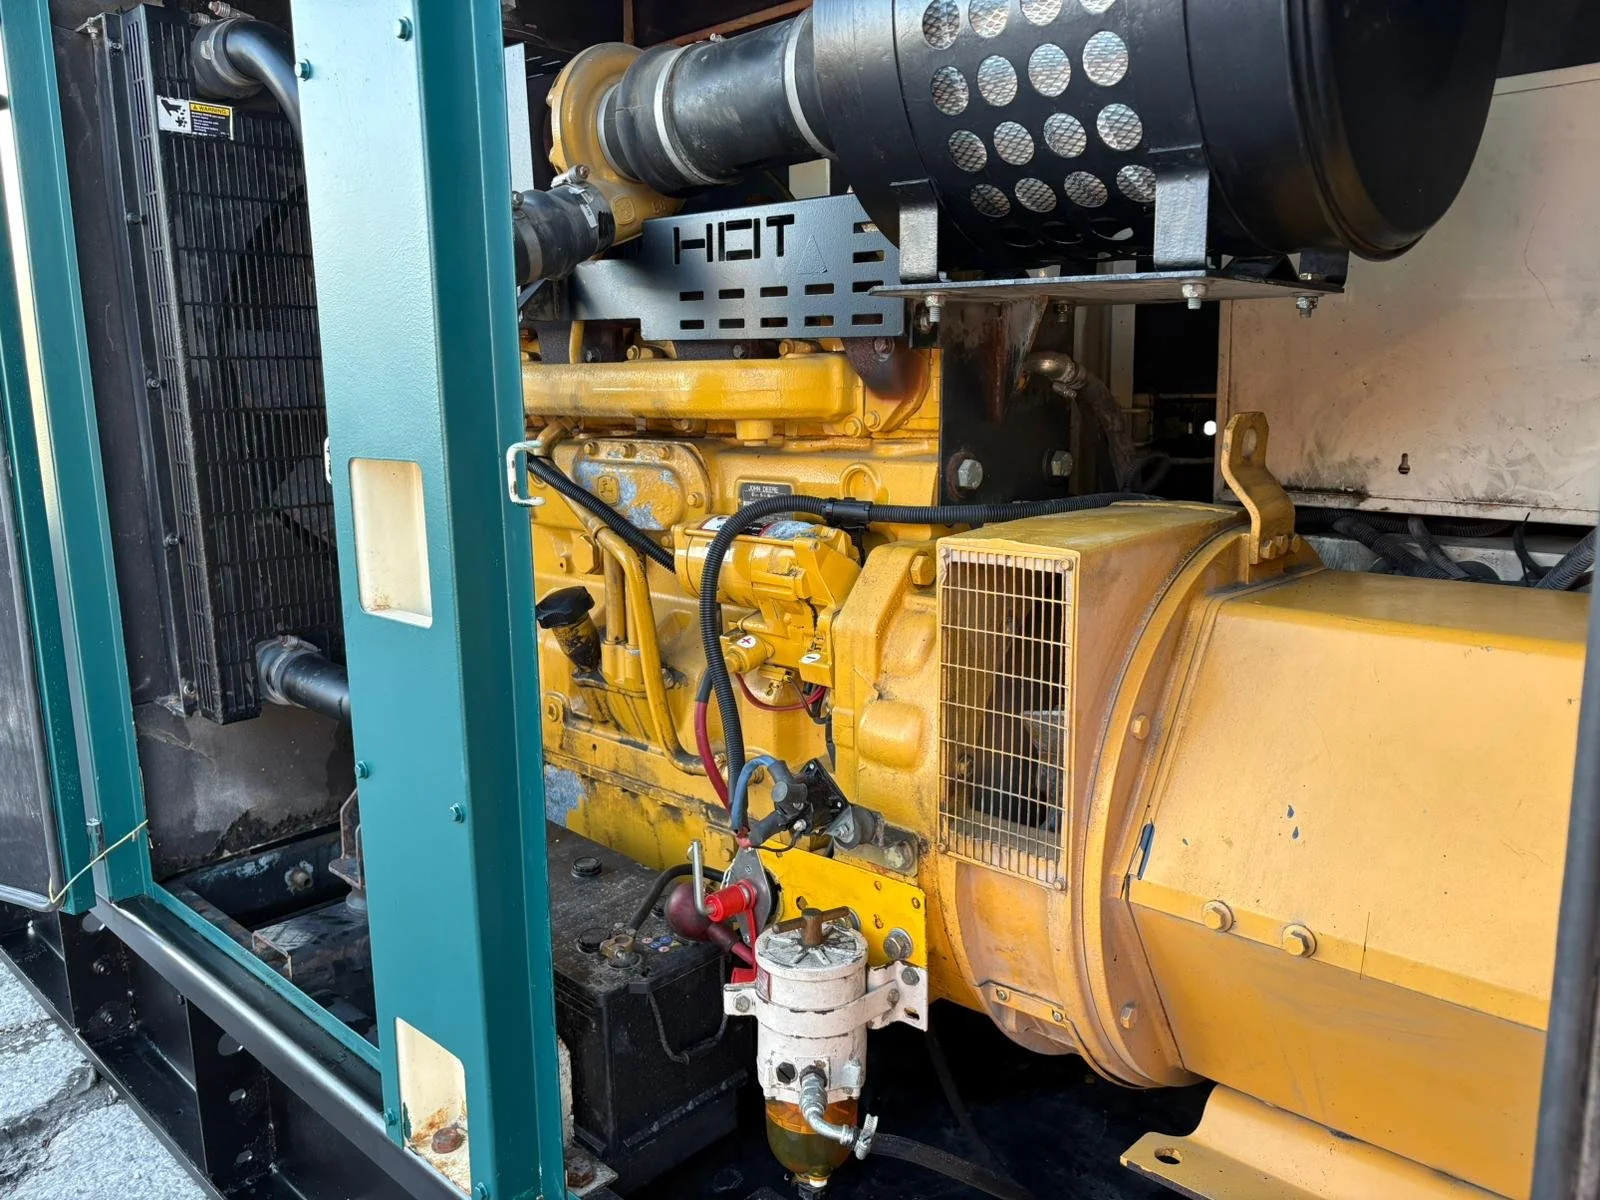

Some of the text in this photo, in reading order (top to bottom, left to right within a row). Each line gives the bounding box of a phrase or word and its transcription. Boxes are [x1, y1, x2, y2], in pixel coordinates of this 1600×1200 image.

[198, 105, 227, 114] WARNING
[673, 214, 795, 264] HOT
[748, 485, 779, 494] JOHN DEERE
